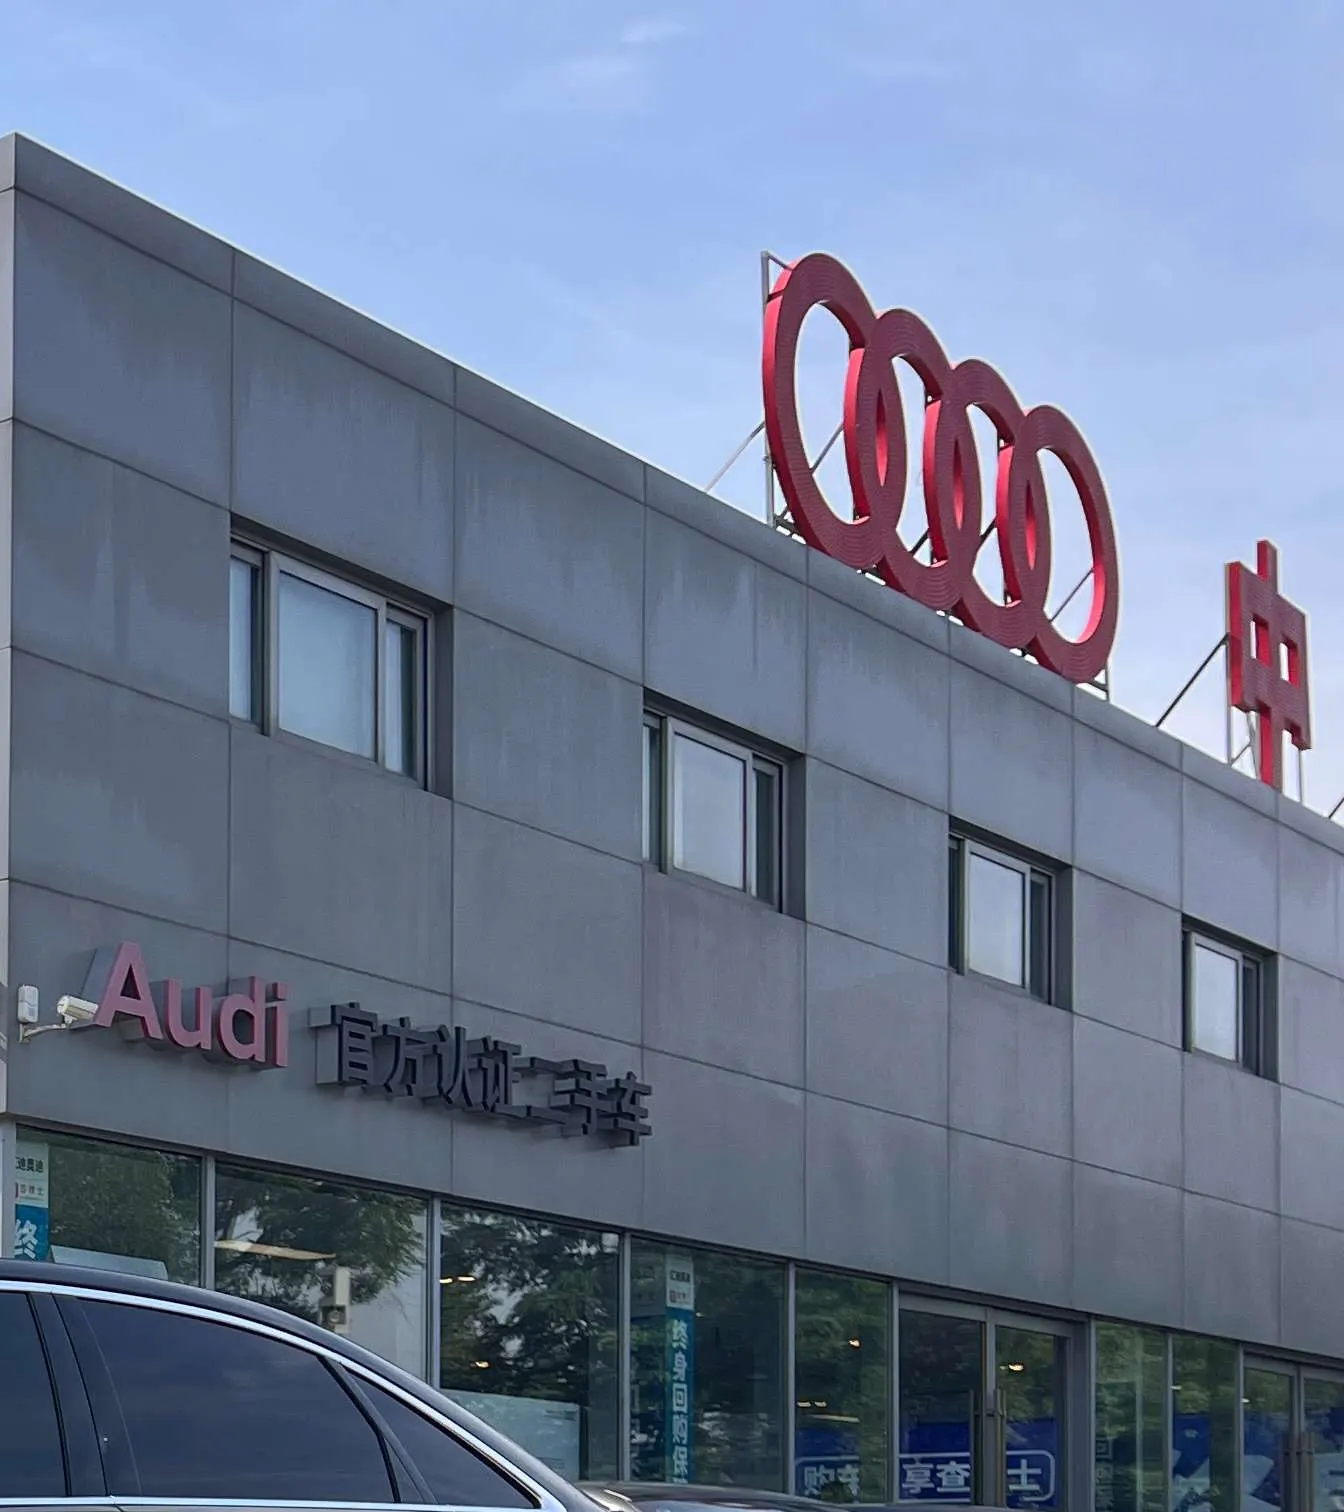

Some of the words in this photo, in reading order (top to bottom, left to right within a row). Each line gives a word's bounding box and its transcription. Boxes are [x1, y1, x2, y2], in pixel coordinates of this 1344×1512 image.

[1225, 540, 1312, 789] 中
[90, 942, 290, 1068] Audi
[322, 1002, 653, 1147] 官方认证二手车
